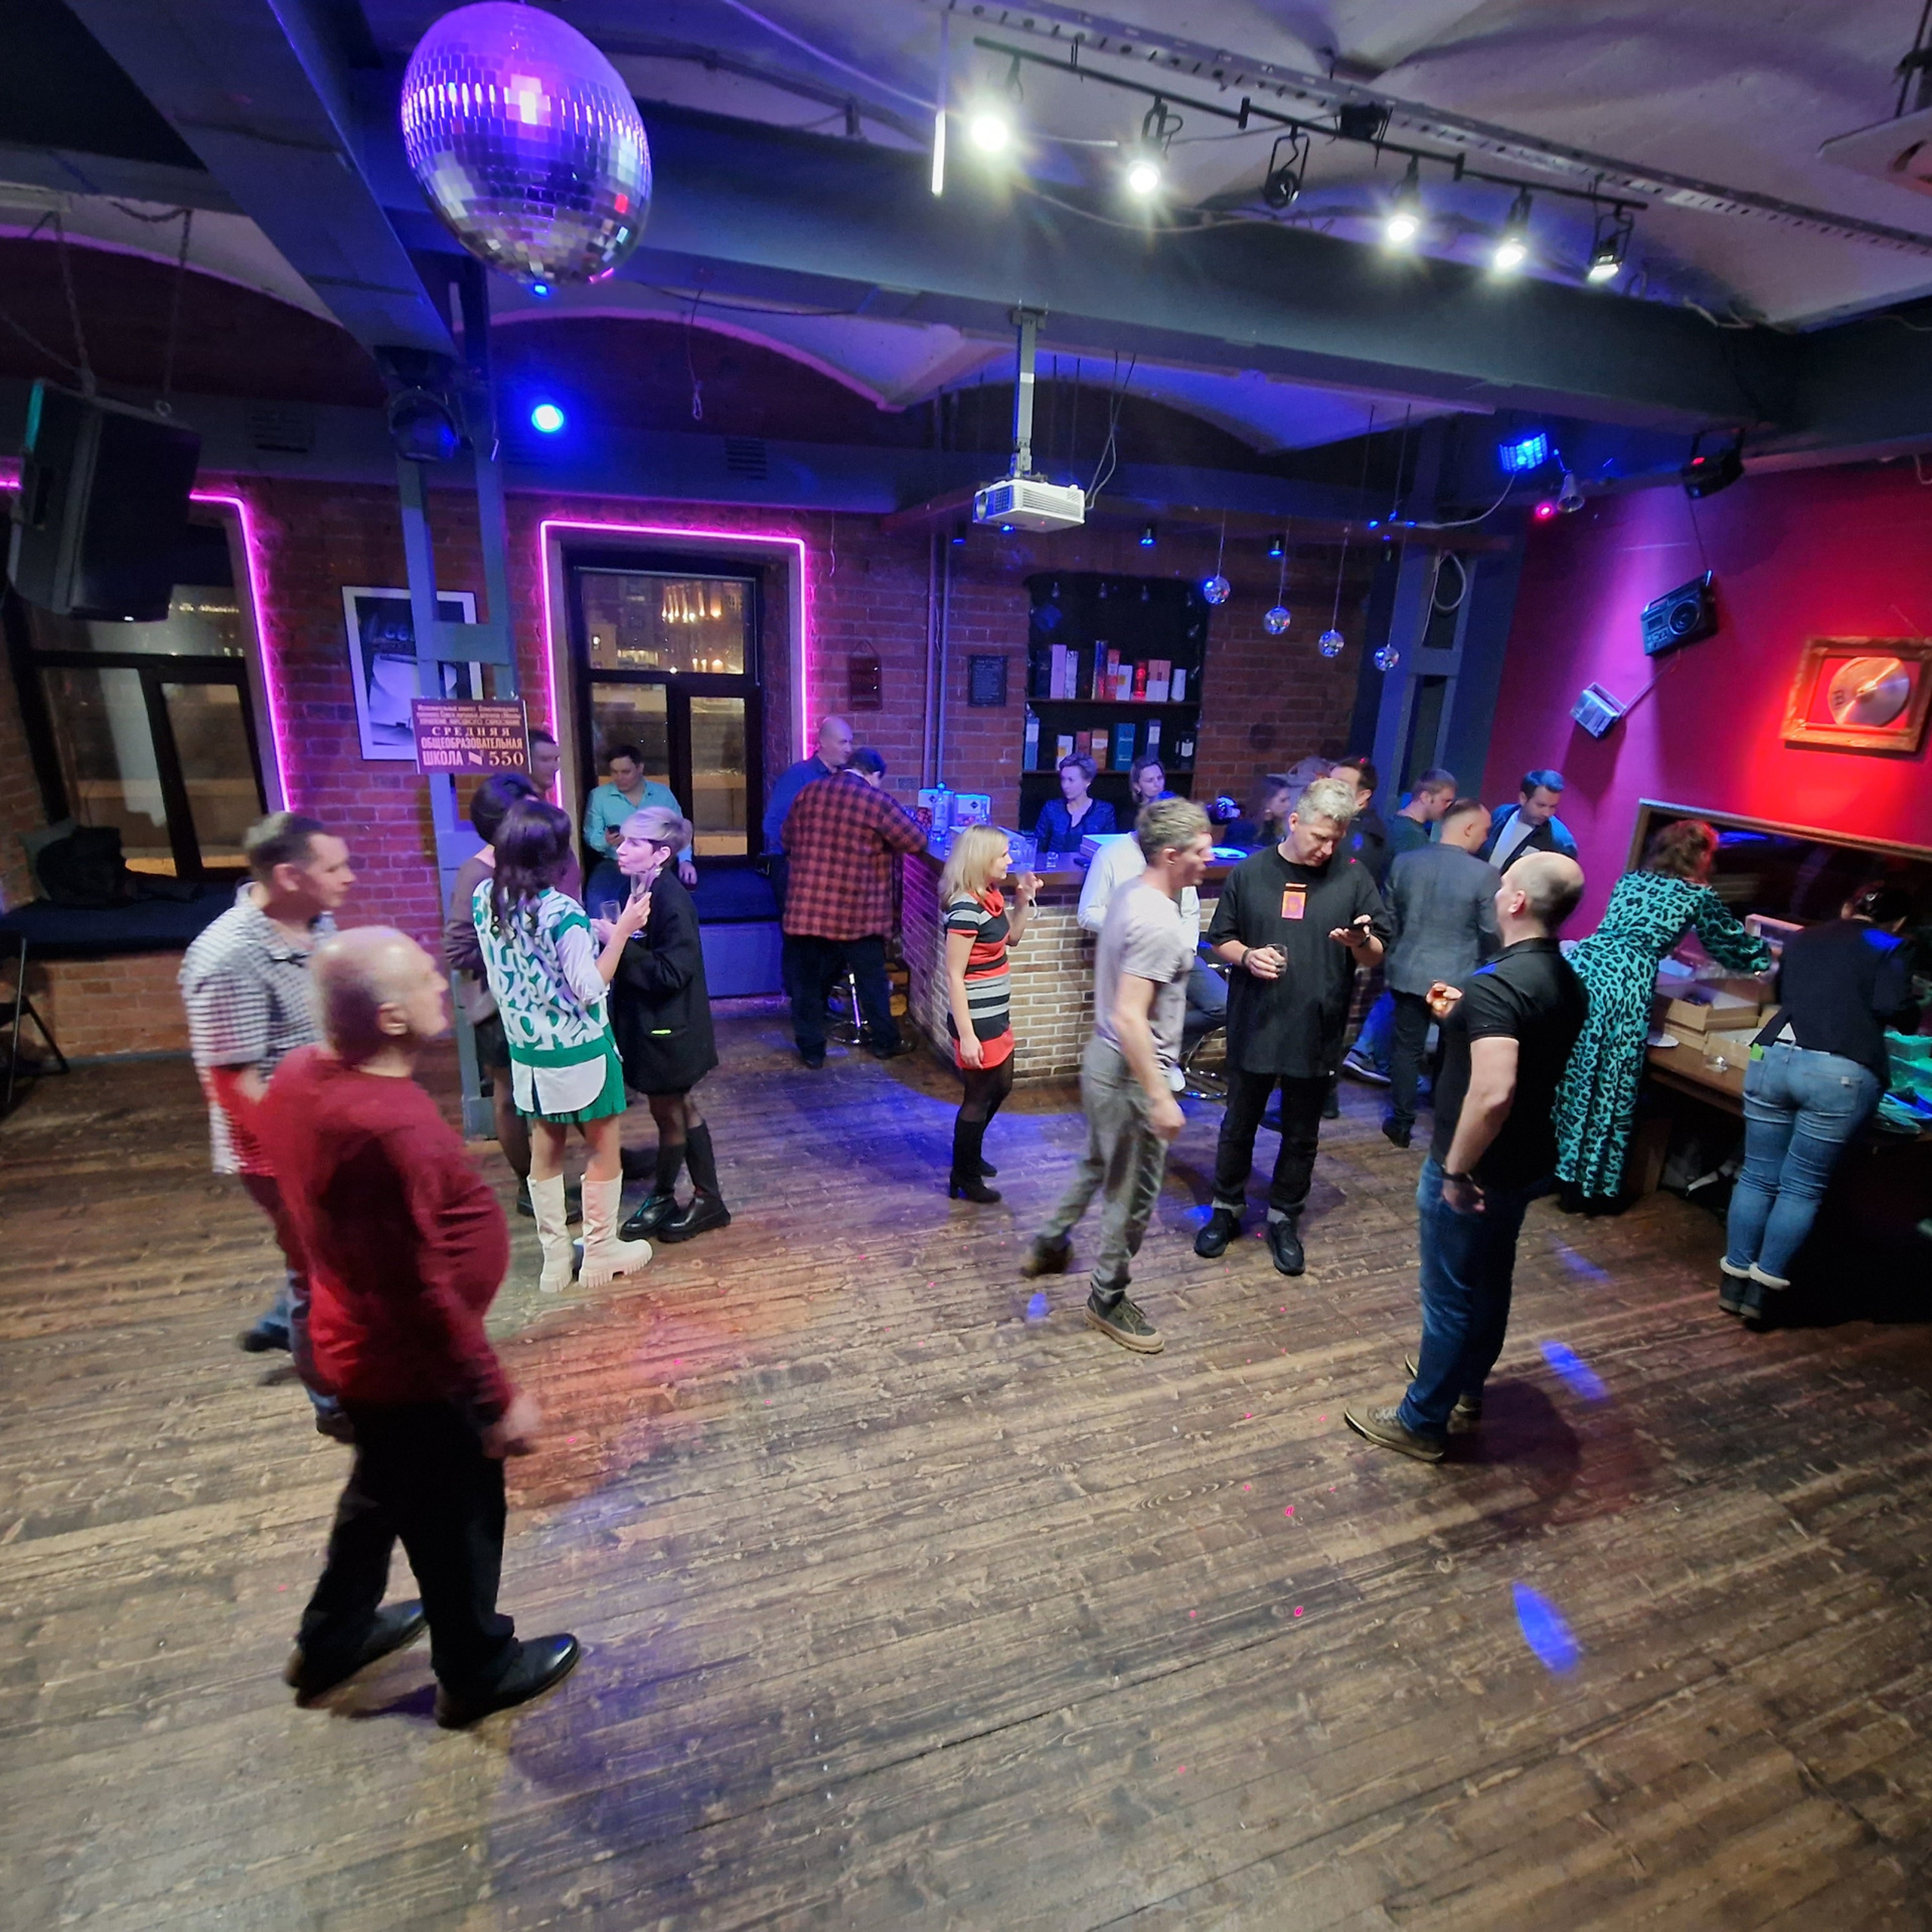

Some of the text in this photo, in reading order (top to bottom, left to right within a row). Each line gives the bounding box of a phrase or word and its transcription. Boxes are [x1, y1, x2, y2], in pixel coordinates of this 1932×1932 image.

[432, 727, 510, 737] СРЕДНЯЯ
[420, 737, 523, 749] ОБЩЕОБРАЗОВАТЕЛЬНАЯ
[423, 750, 464, 766] ШКОЛА
[489, 752, 525, 766] 550
